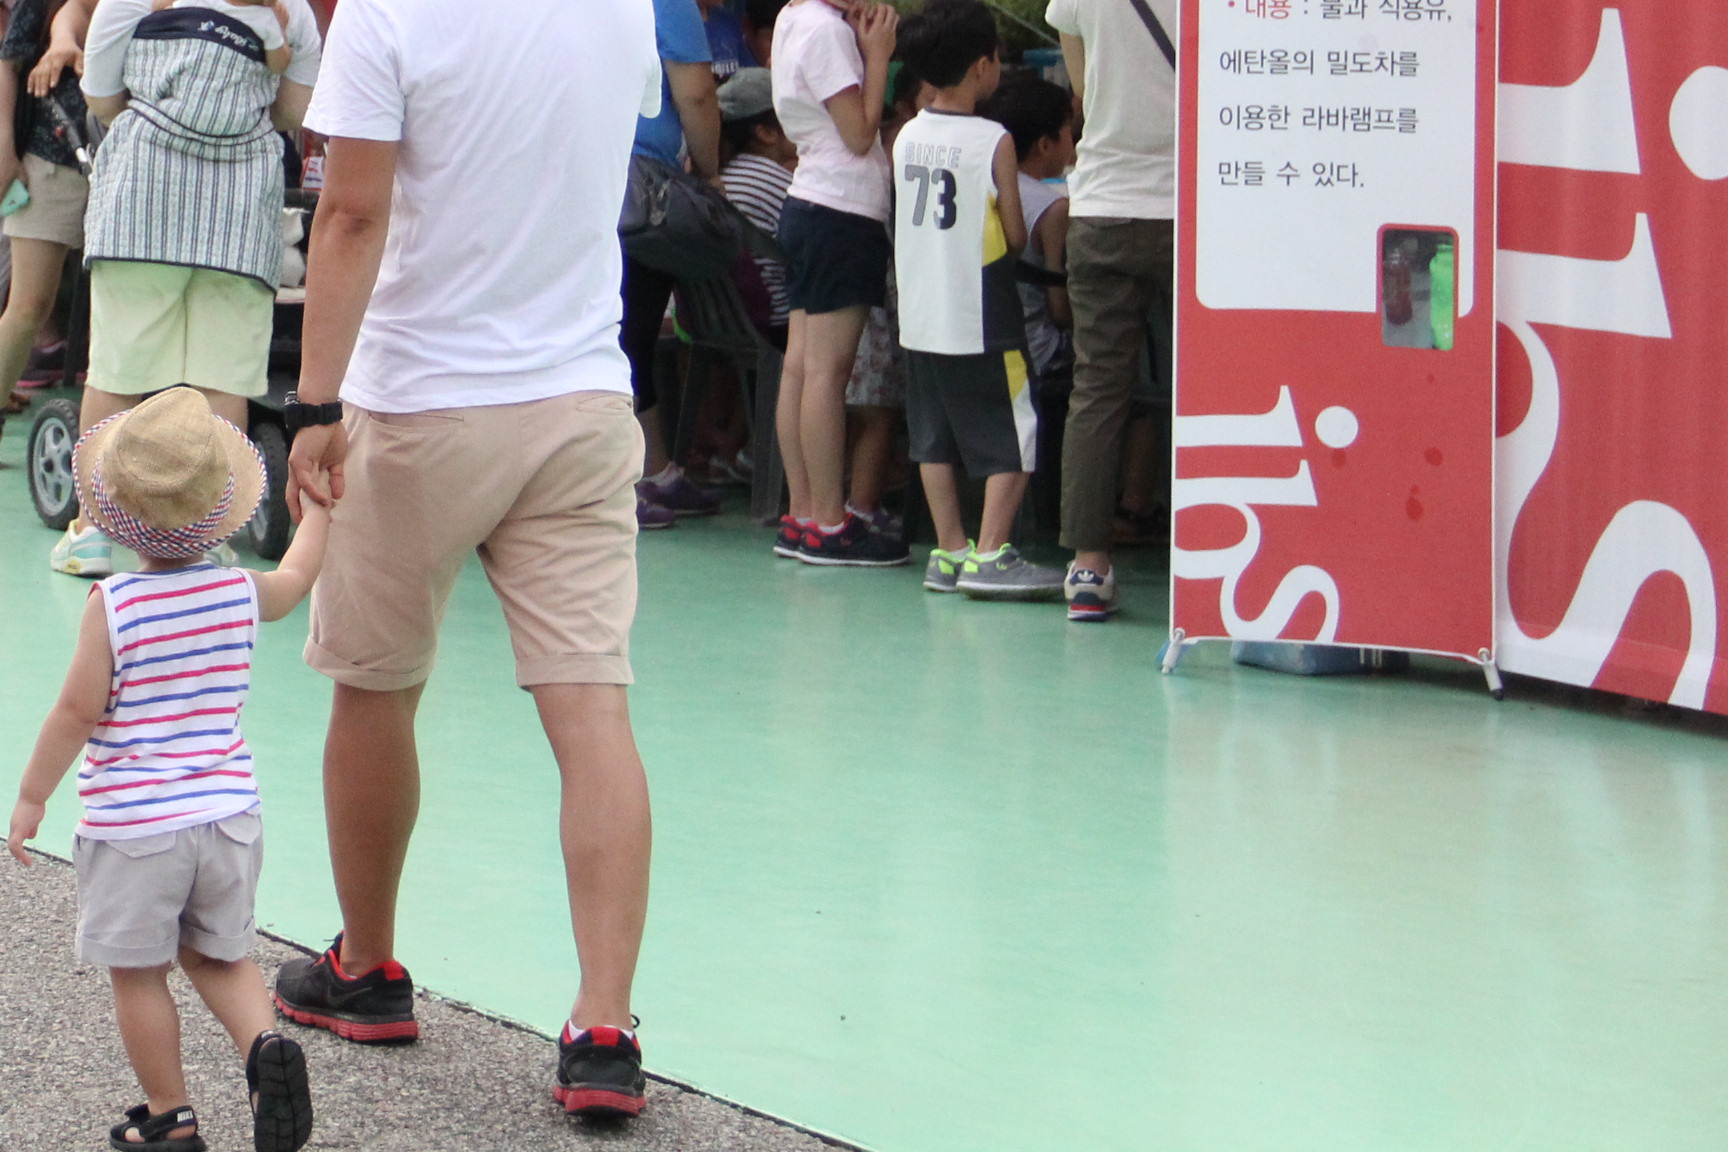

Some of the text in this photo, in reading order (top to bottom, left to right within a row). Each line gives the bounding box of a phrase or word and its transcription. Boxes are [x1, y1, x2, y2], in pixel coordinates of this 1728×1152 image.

[1219, 48, 1420, 77] 에탄올의 밀도차를
[1219, 104, 1419, 134] 이용한 라바램프를
[904, 142, 962, 169] SINCE
[1218, 160, 1365, 188] 만들 수 있다.
[904, 165, 958, 230] 73
